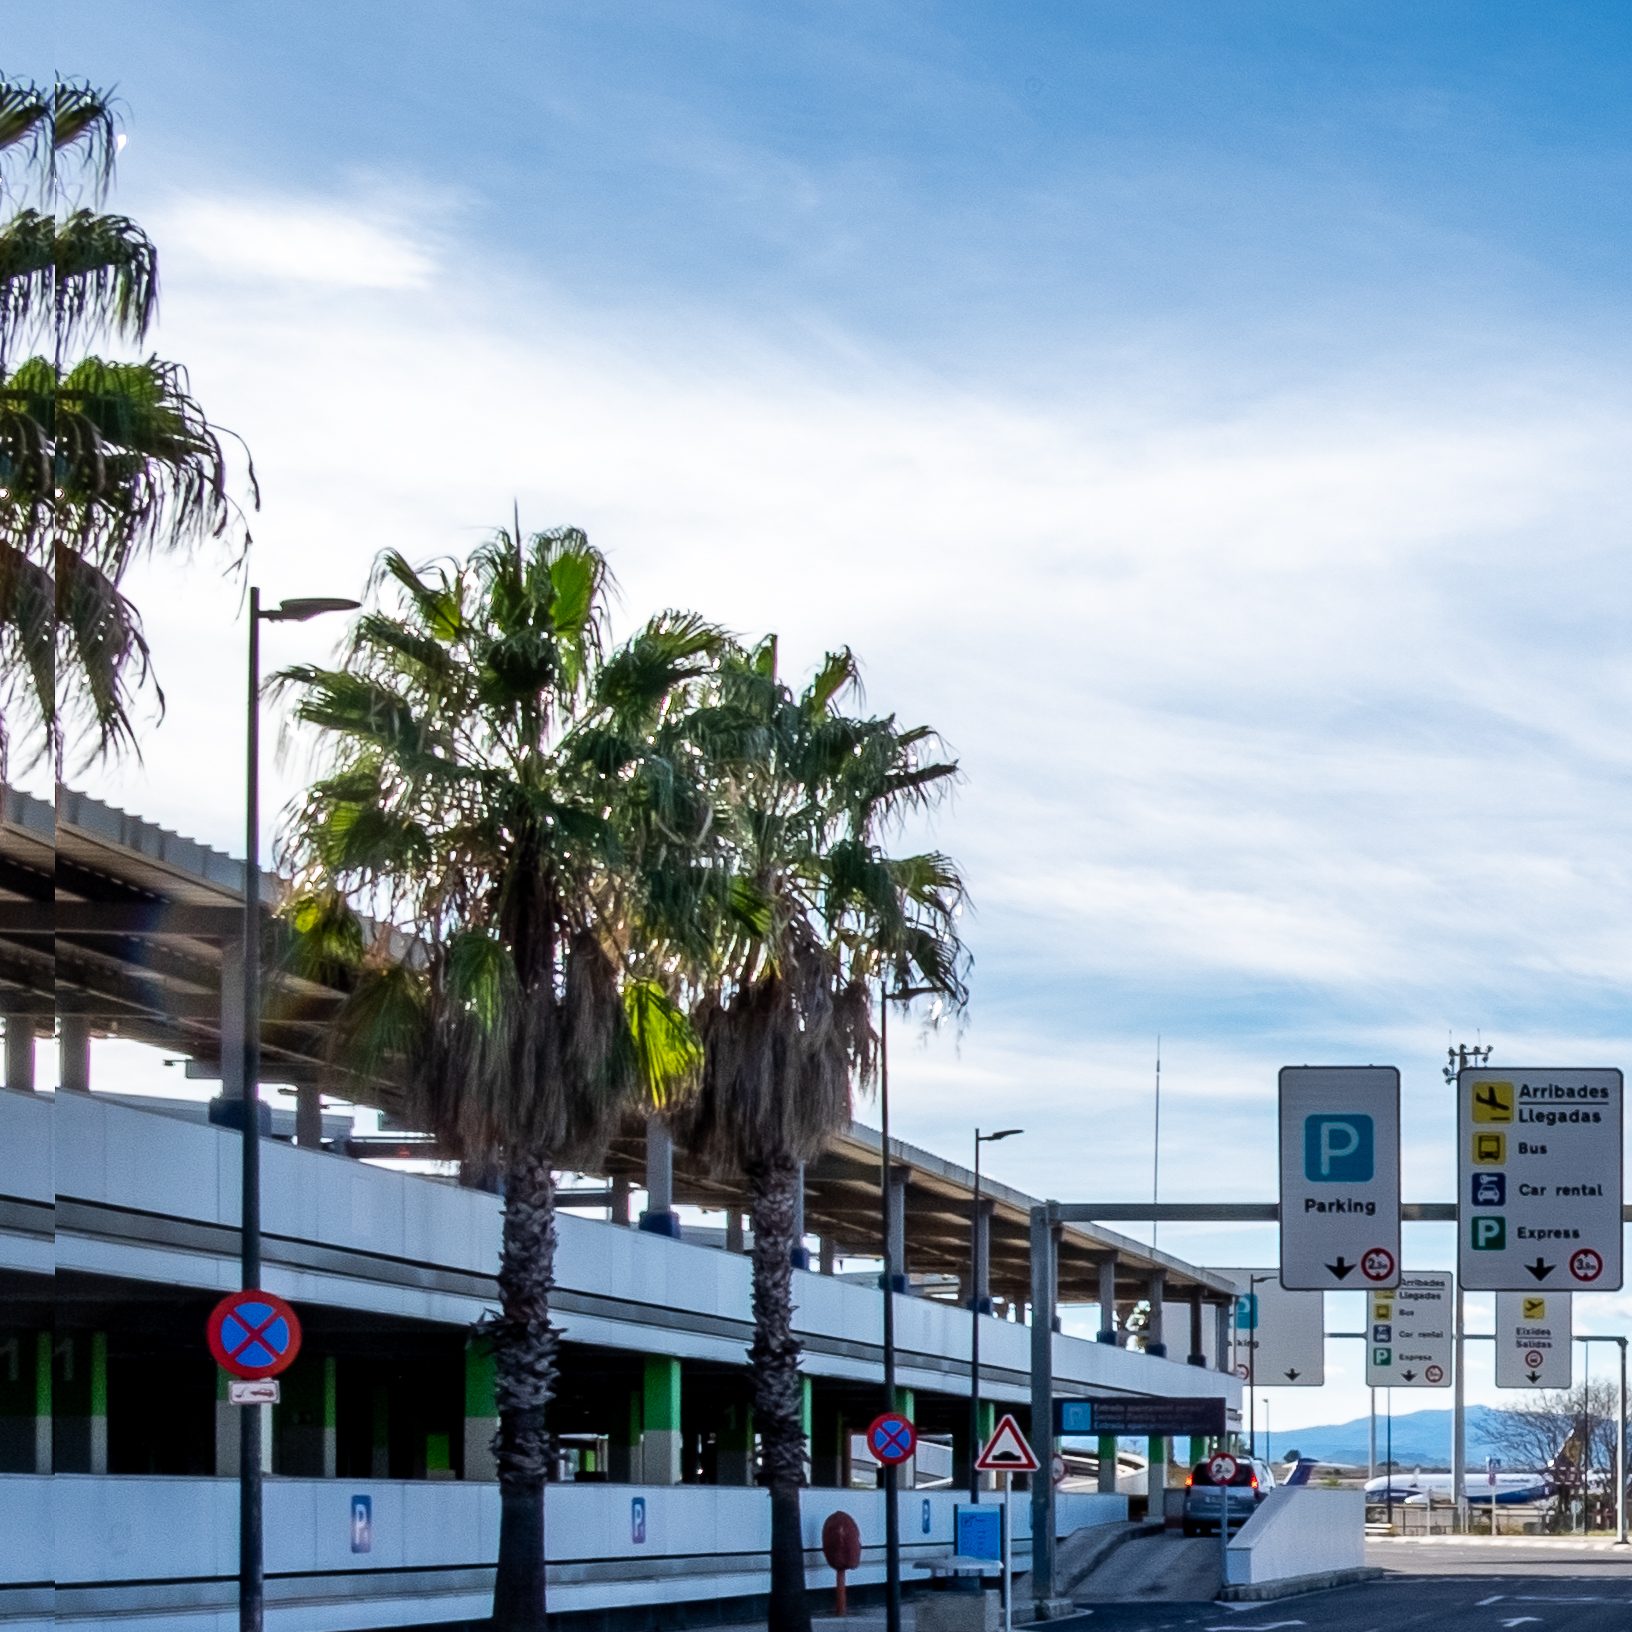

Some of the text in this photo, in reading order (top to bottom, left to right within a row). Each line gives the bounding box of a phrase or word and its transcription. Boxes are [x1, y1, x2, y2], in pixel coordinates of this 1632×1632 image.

[1519, 1083, 1609, 1099] Arribades
[1518, 1108, 1602, 1126] Llegadas
[1321, 1121, 1359, 1176] P
[1518, 1142, 1548, 1155] Bus
[1518, 1183, 1603, 1197] Car rental
[1304, 1198, 1376, 1217] Parking
[1477, 1220, 1581, 1247] P Express
[1376, 1350, 1388, 1364] P
